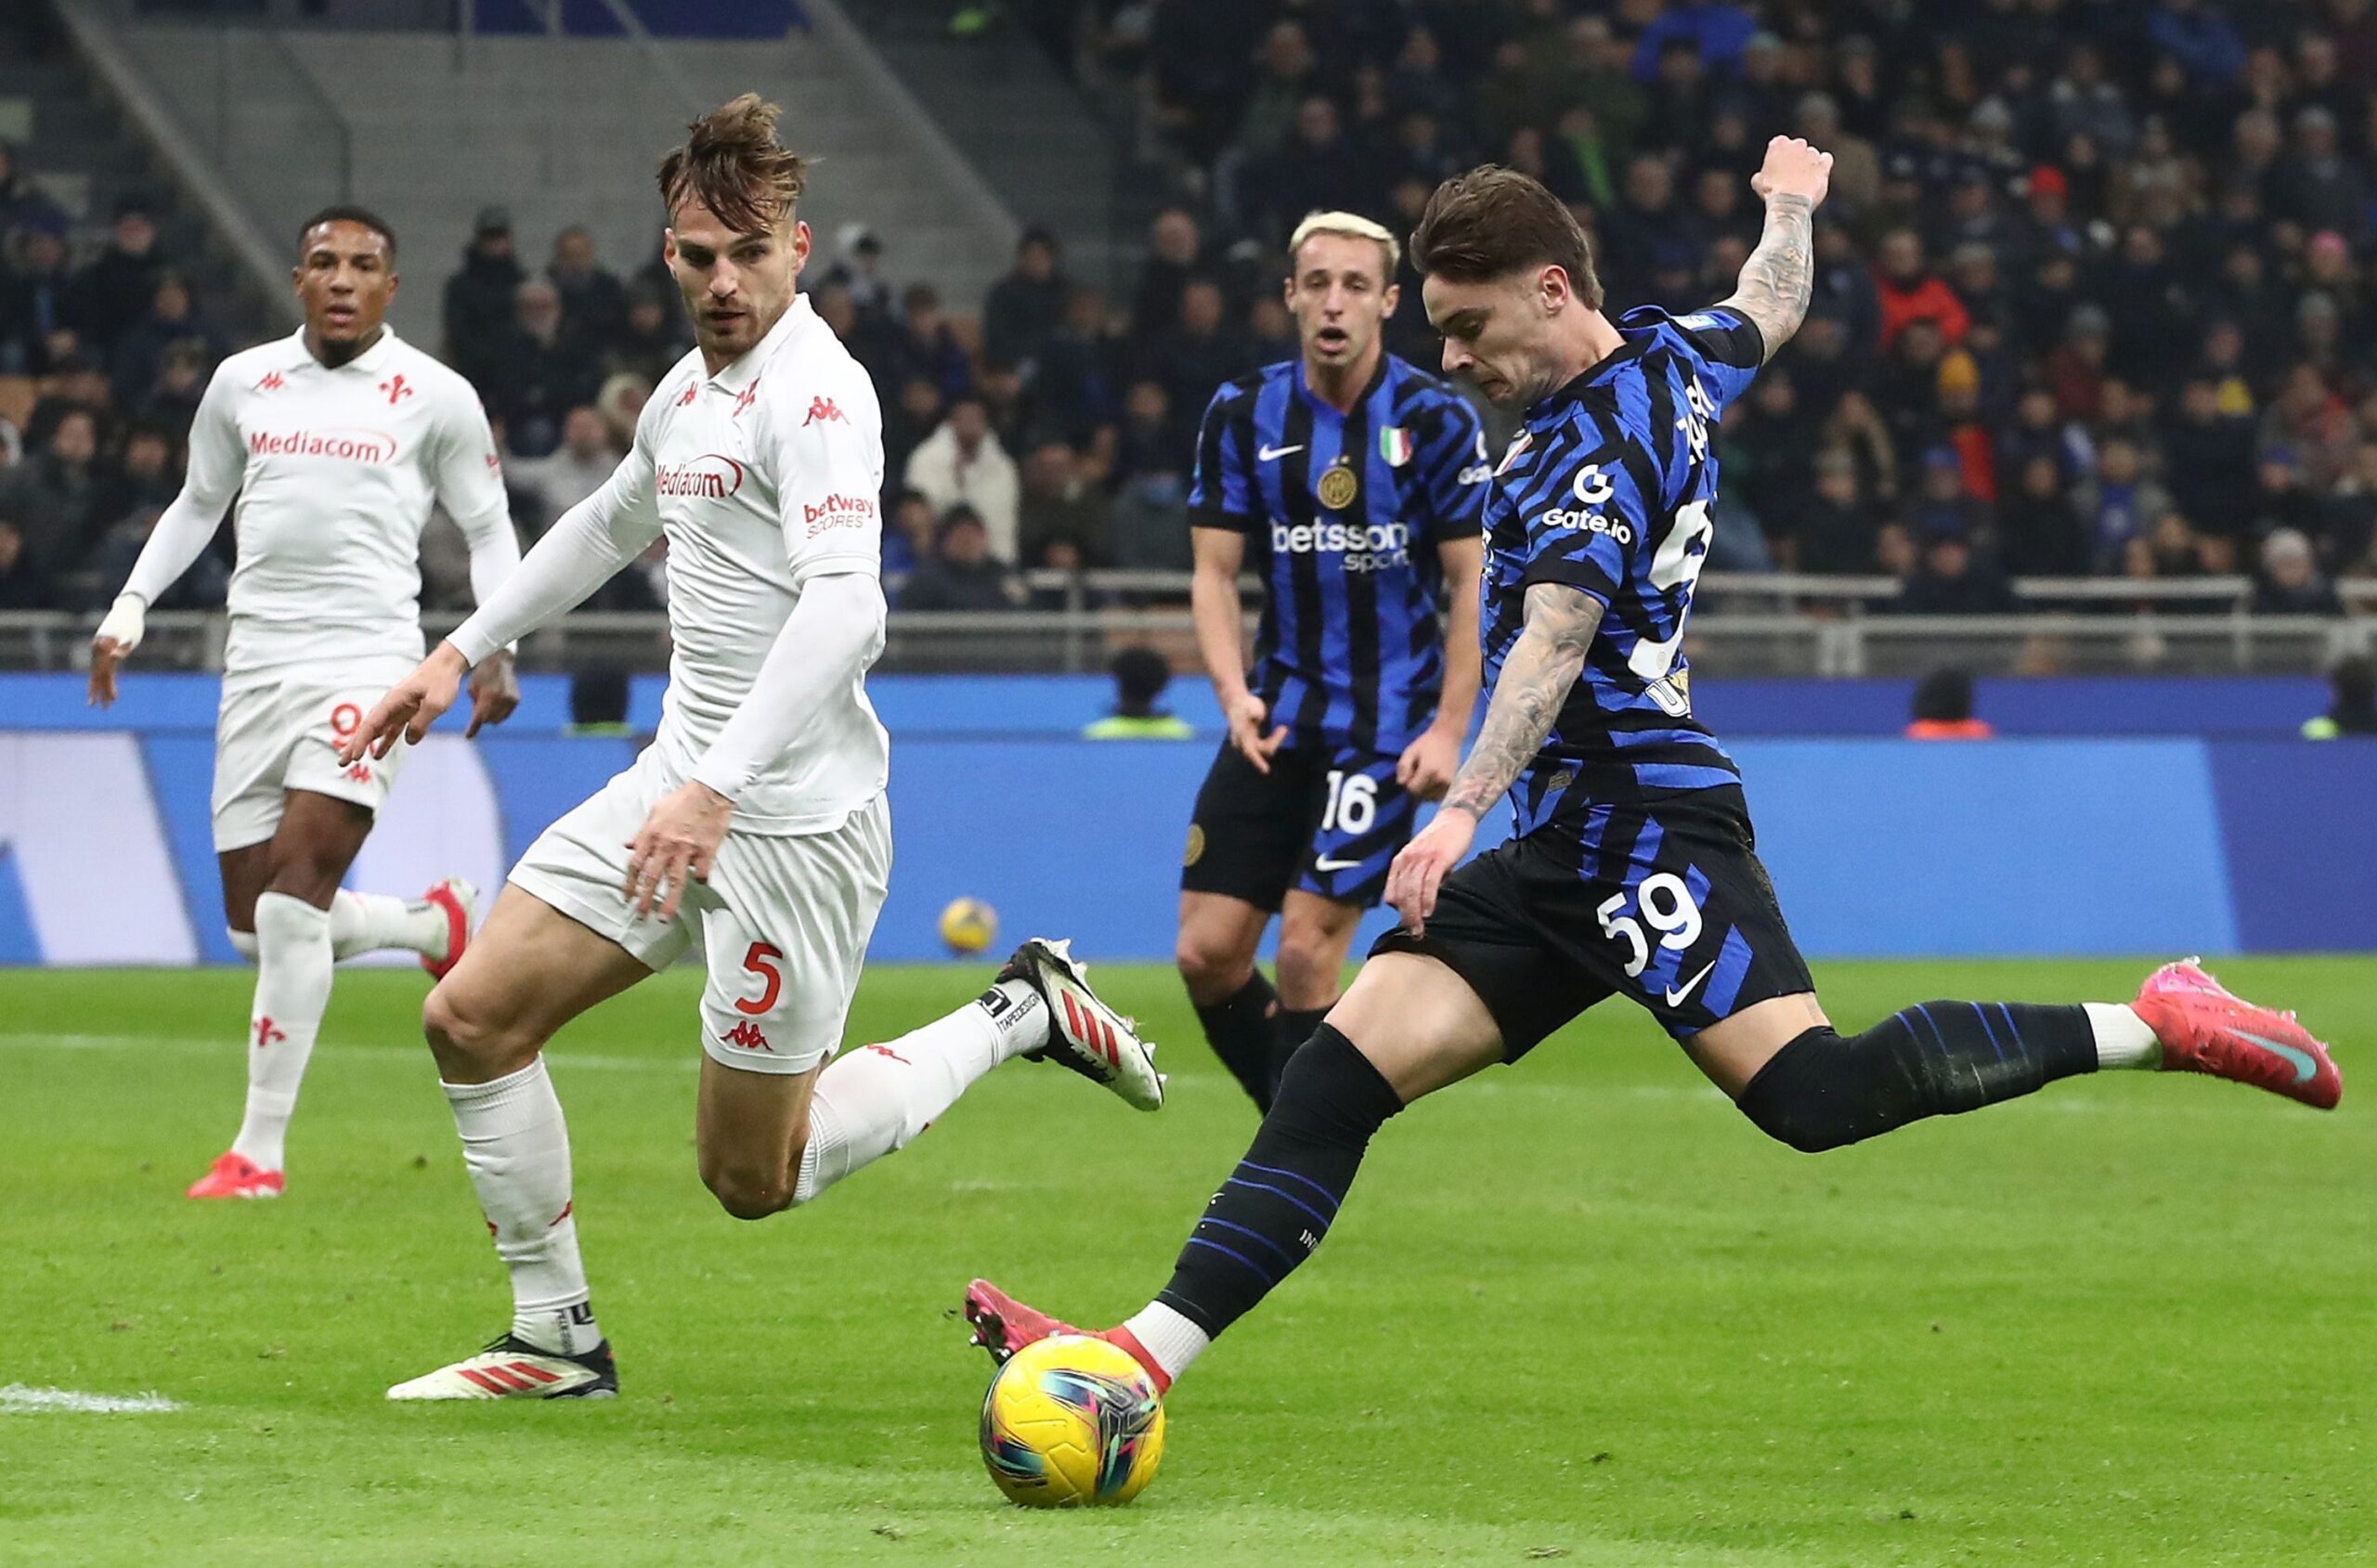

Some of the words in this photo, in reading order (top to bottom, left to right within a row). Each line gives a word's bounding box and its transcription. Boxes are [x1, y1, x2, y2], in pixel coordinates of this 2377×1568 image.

[251, 431, 380, 462] Mediacom
[655, 463, 725, 498] Mediacom
[803, 493, 873, 524] betway
[806, 514, 864, 539] SCORES
[1541, 507, 1631, 545] Gate.io
[1268, 516, 1409, 553] betsson
[1321, 770, 1378, 835] 16
[1596, 872, 1703, 978] 59
[734, 940, 783, 1015] 5
